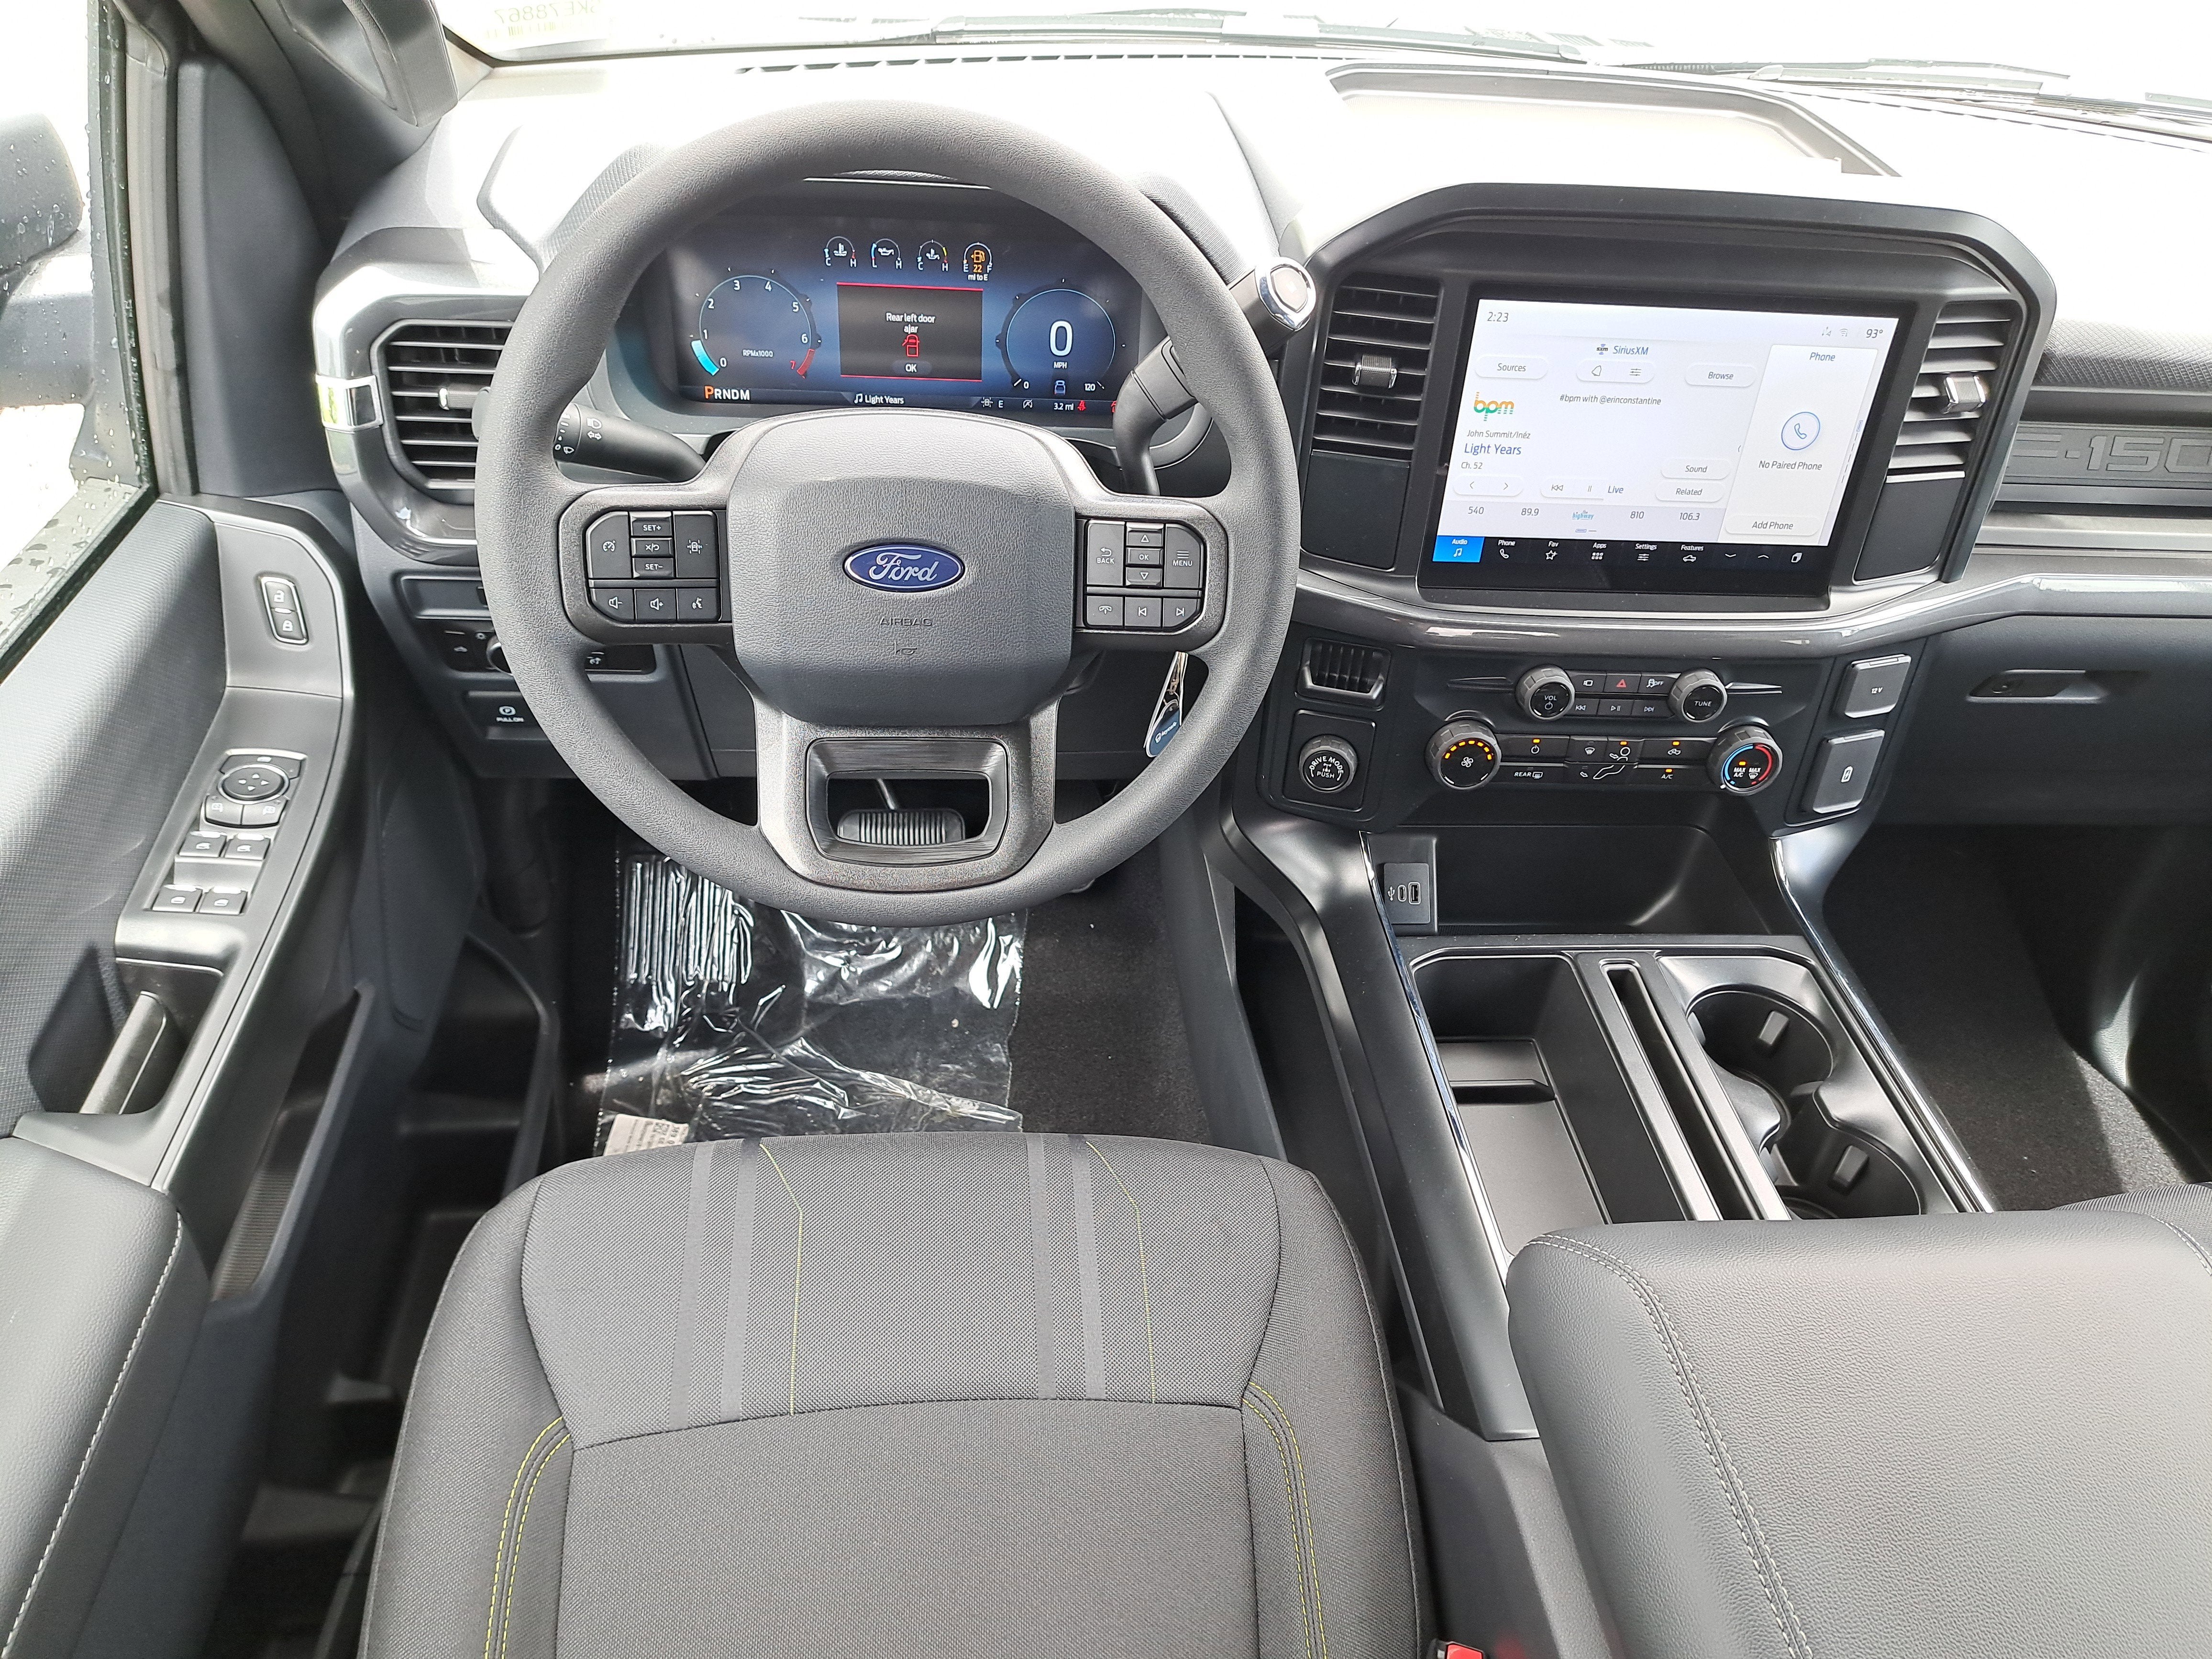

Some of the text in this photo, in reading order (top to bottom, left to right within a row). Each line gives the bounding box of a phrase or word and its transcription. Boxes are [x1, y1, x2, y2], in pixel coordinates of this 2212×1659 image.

[825, 257, 831, 266] C
[850, 259, 856, 267] H
[872, 259, 877, 268] L
[896, 260, 902, 269] H
[918, 262, 923, 270] C
[942, 263, 948, 272] H
[963, 264, 969, 272] E
[973, 265, 983, 273] 22
[986, 265, 992, 273] F
[733, 280, 741, 290] 3
[765, 281, 772, 291] 4
[708, 299, 715, 309] 2
[792, 302, 799, 312] 5
[886, 313, 935, 323] Rear left door
[1487, 312, 1508, 322] 2:23
[904, 324, 918, 334] ajar
[703, 330, 708, 339] 1
[1050, 321, 1073, 356] 0
[1866, 329, 1883, 339] 93°
[801, 334, 808, 344] 6
[1613, 345, 1648, 355] SiriusXM
[1809, 352, 1836, 362] Phone
[720, 358, 727, 367] 0
[790, 361, 796, 369] 7
[905, 364, 917, 373] OK
[1497, 363, 1526, 372] Sources
[1708, 372, 1734, 380] Browse
[1023, 381, 1029, 389] 0
[864, 396, 904, 405] Light Years
[1560, 394, 1661, 405] #bpm with @erinconstantine
[1053, 402, 1064, 410] 3.2
[1473, 391, 1515, 421] bpm
[1467, 430, 1483, 438] John
[1464, 443, 1522, 456] Light Years
[1461, 462, 1471, 470] Ch.
[1685, 465, 1707, 473] Sound
[1759, 461, 1822, 470] No Paired Phone
[1521, 508, 1539, 516] 89.9
[1630, 511, 1644, 519] 810
[1680, 512, 1700, 520] 106.3
[1769, 522, 1793, 530] Phone
[869, 552, 939, 582] Ford
[880, 618, 932, 626] AIRBAG
[1309, 756, 1344, 774] DRIVE MODE
